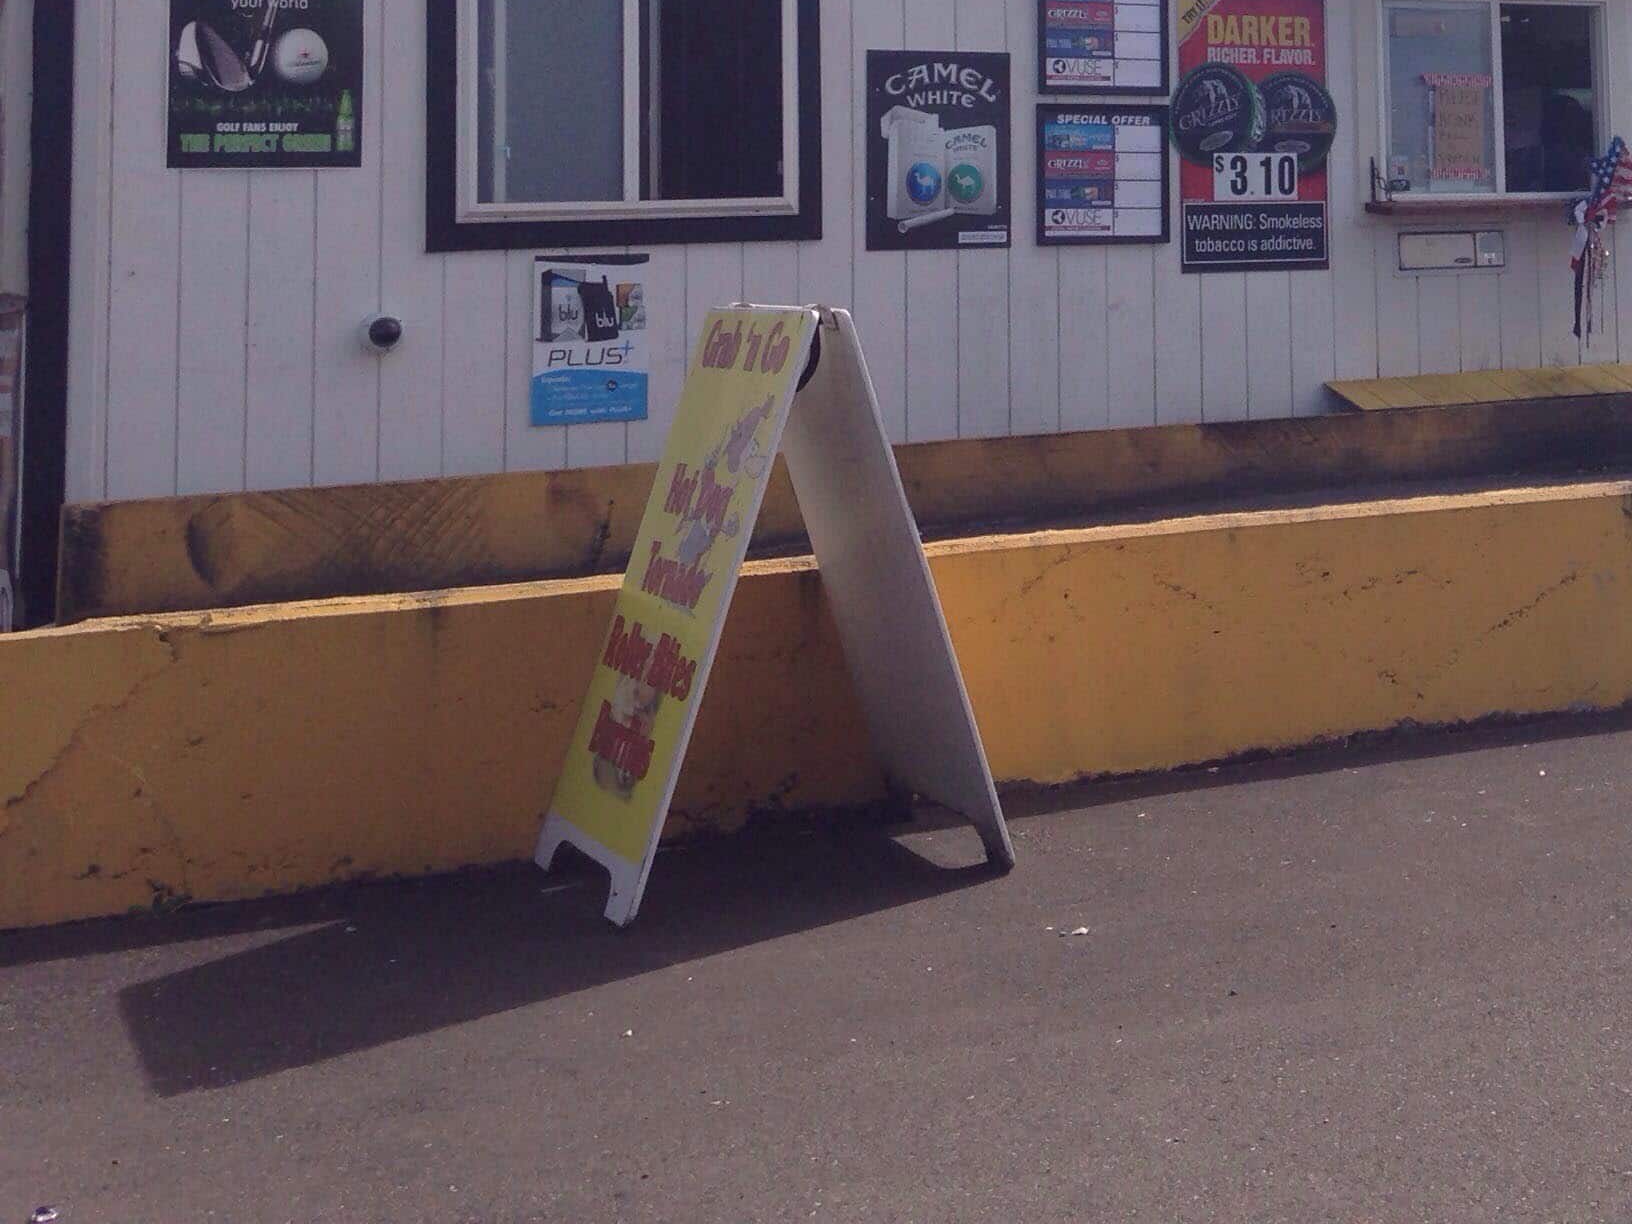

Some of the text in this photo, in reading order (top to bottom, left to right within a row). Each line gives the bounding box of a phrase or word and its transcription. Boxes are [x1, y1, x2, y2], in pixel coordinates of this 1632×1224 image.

[1182, 7, 1199, 24] TRY
[1207, 14, 1315, 47] DARKER.
[1207, 47, 1316, 65] RICHER. FLAVOR.
[885, 62, 999, 103] CAMEL
[905, 89, 977, 109] WHITE
[1056, 113, 1151, 127] SPECIAL OFFER
[1270, 107, 1321, 123] RIZZLY
[216, 122, 241, 132] GOLF
[242, 122, 267, 132] FANS
[945, 132, 988, 151] CAMEL
[1259, 213, 1323, 230] Smokeless
[1195, 236, 1316, 252] tobacco is addictive.
[559, 303, 578, 322] blu
[595, 311, 614, 328] blu
[760, 322, 791, 375] Go
